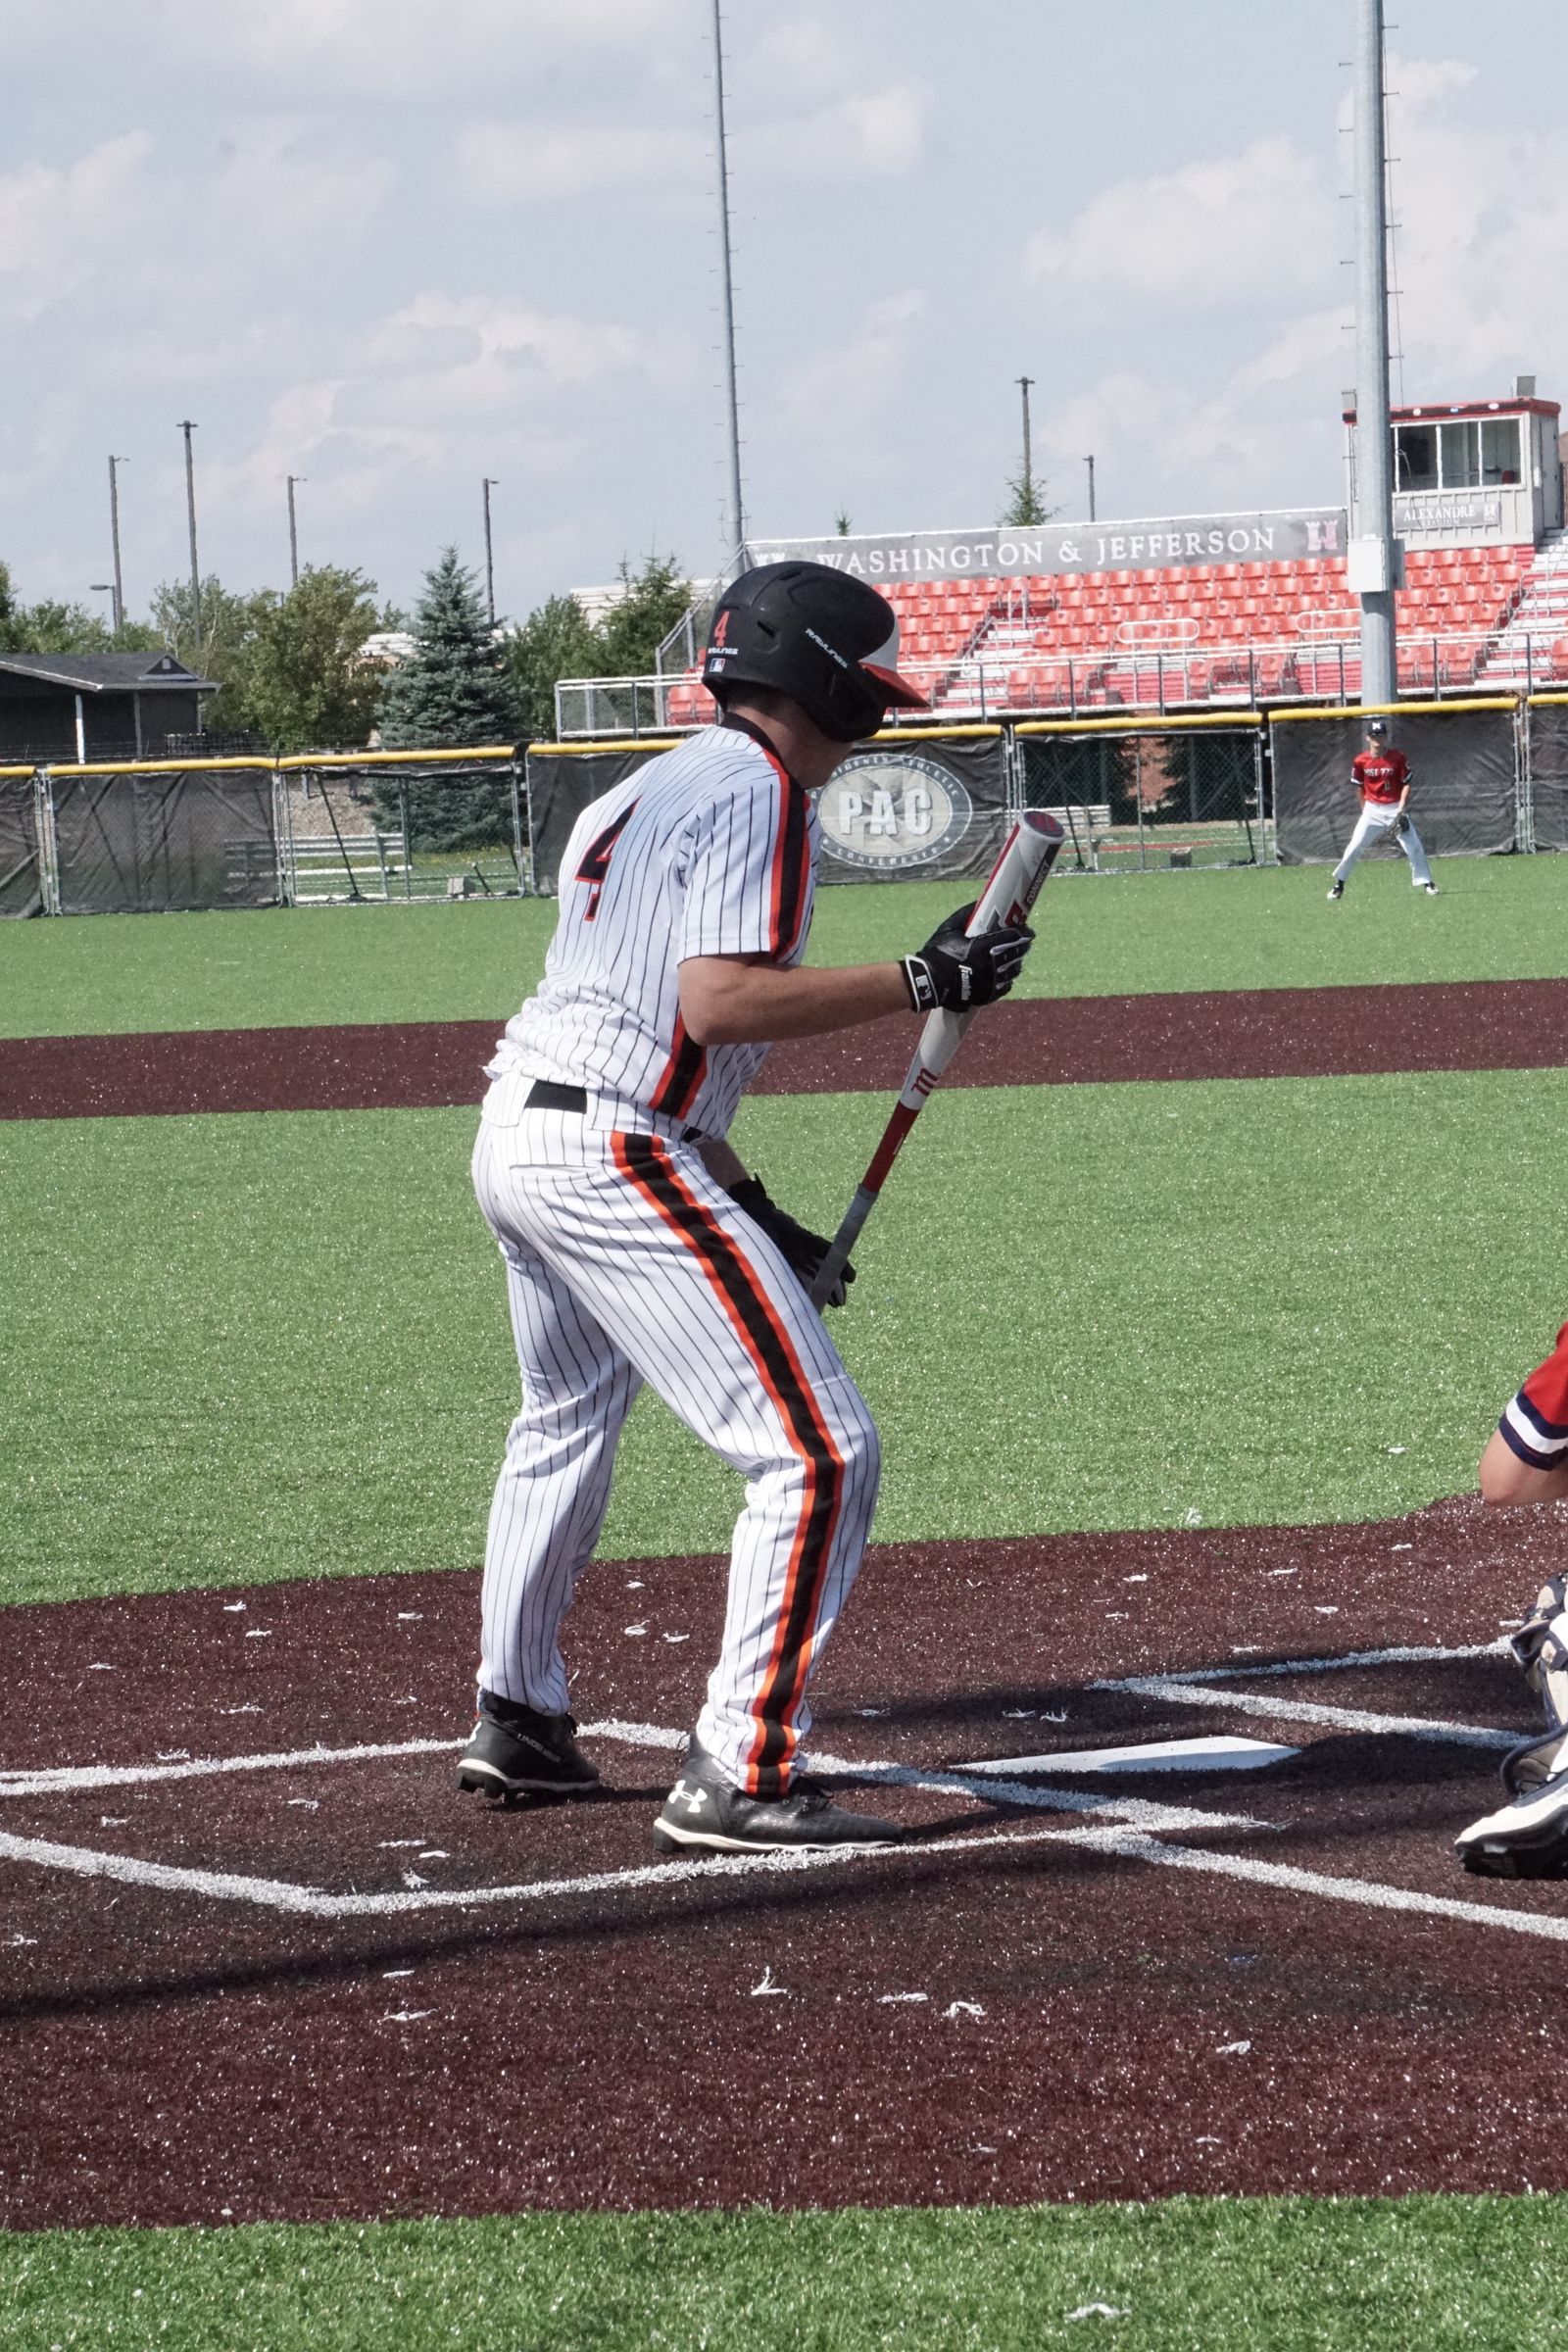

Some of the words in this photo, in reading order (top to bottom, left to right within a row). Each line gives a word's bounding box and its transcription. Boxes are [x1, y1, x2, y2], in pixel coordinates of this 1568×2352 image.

[1402, 505, 1476, 521] ALEXANDRE
[816, 541, 1044, 574] WASHINGTON
[1058, 540, 1082, 563] &
[1097, 527, 1275, 565] JEFFERSON
[713, 611, 730, 647] 4
[805, 627, 849, 668] RAWLINGS
[839, 788, 933, 836] PAC
[574, 795, 643, 922] 4
[1026, 860, 1050, 904] CONNECT
